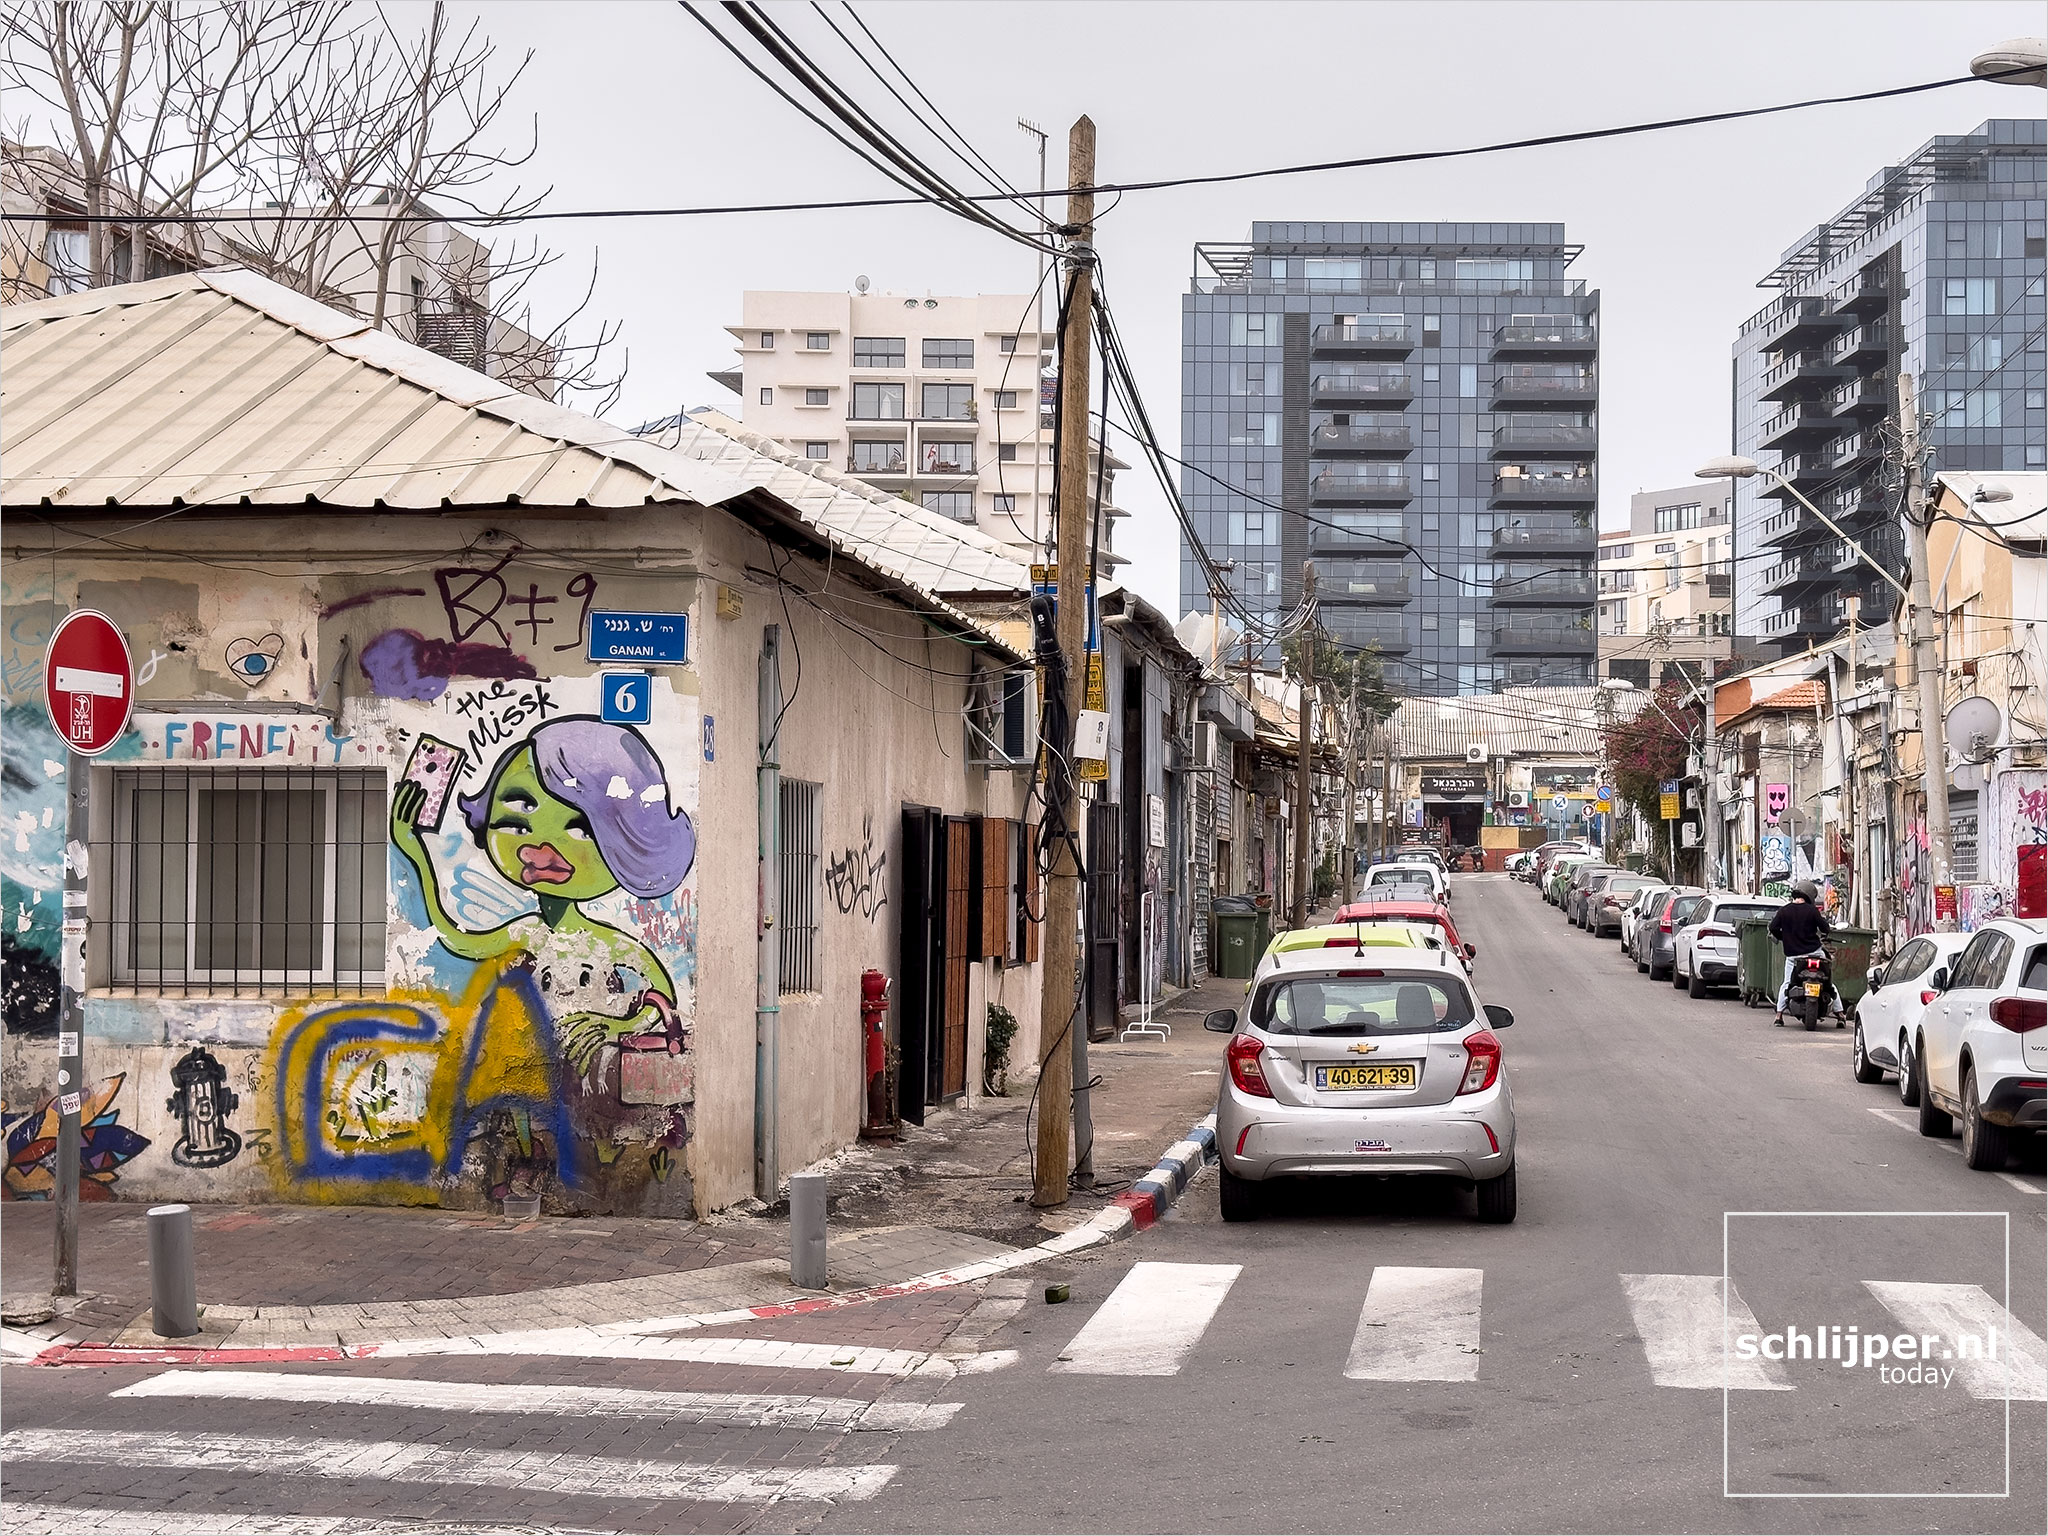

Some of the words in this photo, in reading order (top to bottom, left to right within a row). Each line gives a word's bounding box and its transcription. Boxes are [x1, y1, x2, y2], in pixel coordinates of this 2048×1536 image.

[604, 619, 630, 632] גנני
[609, 645, 654, 656] GANANI
[456, 681, 518, 719] the
[615, 681, 637, 713] 6
[72, 725, 92, 740] UH
